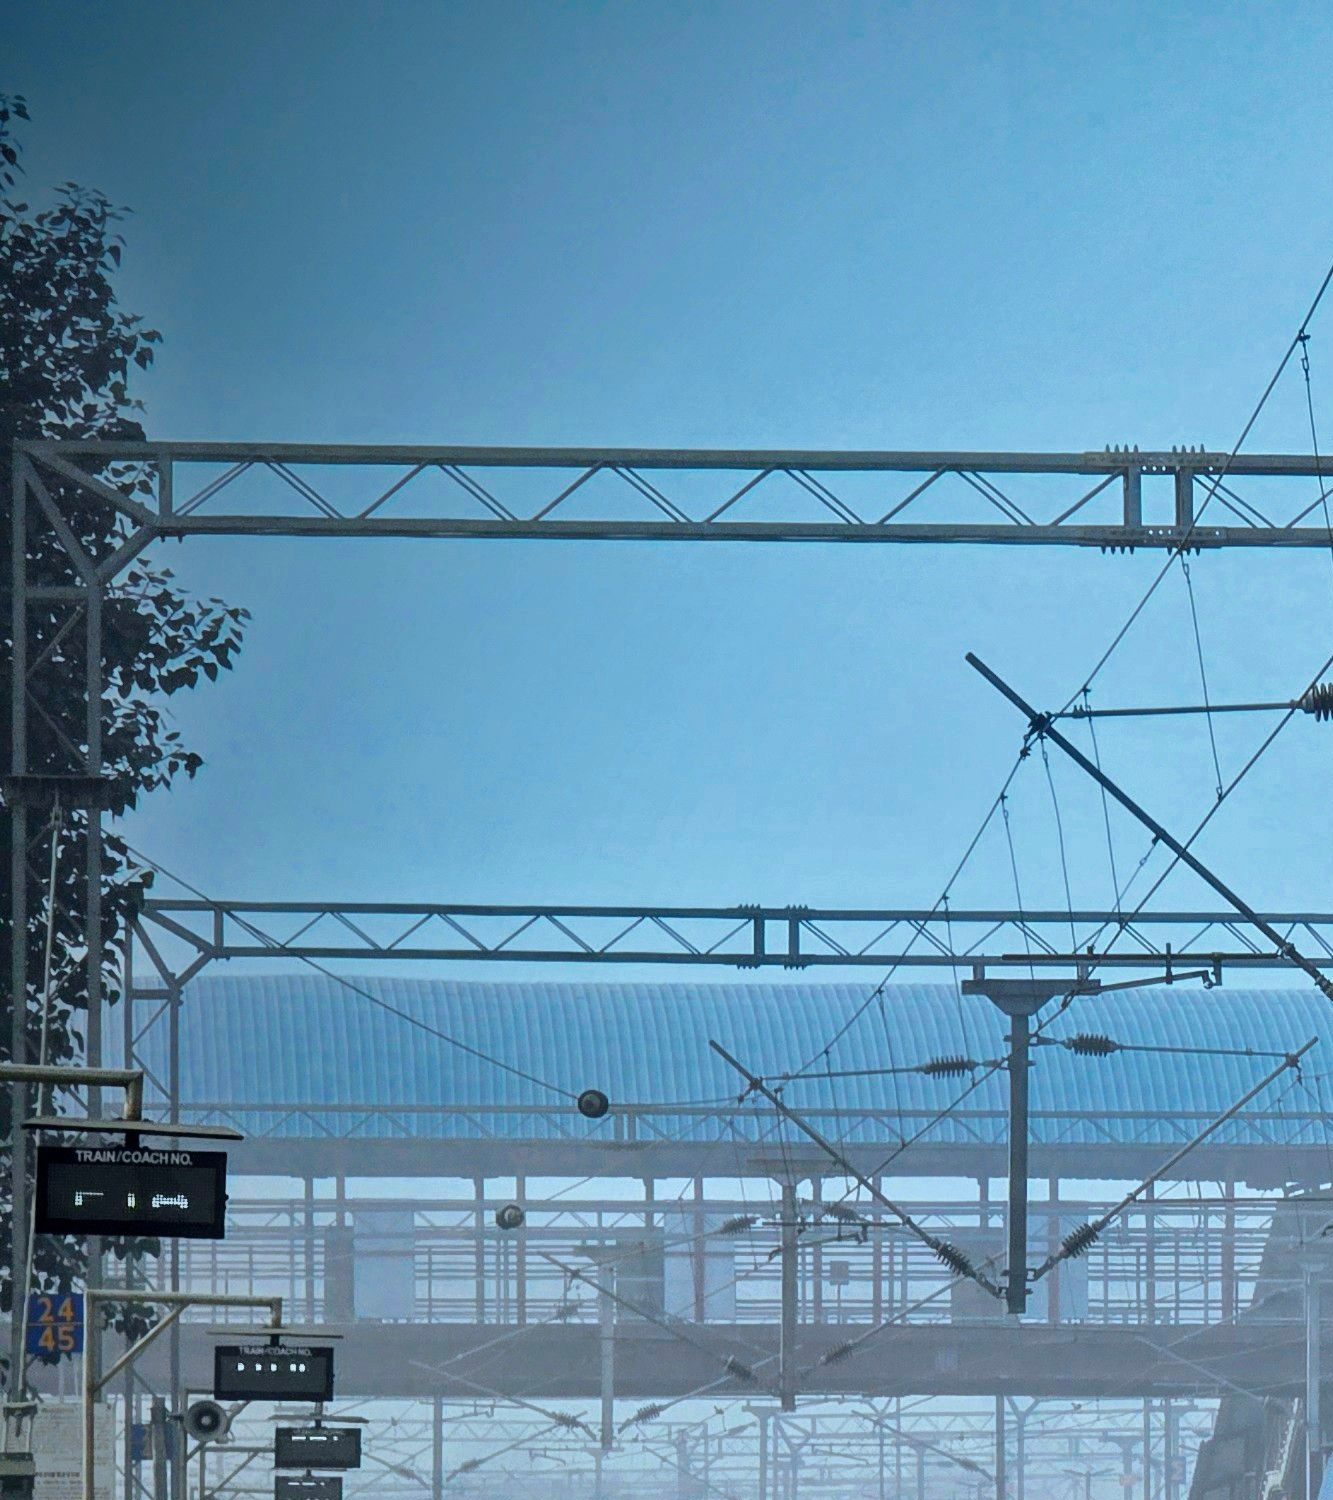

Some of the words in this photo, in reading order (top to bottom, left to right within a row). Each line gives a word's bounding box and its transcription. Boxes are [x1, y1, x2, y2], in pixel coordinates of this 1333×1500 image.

[75, 1149, 169, 1164] TRAIN/COACH
[170, 1152, 193, 1166] NO.
[37, 1296, 74, 1323] 24
[38, 1325, 75, 1352] 45
